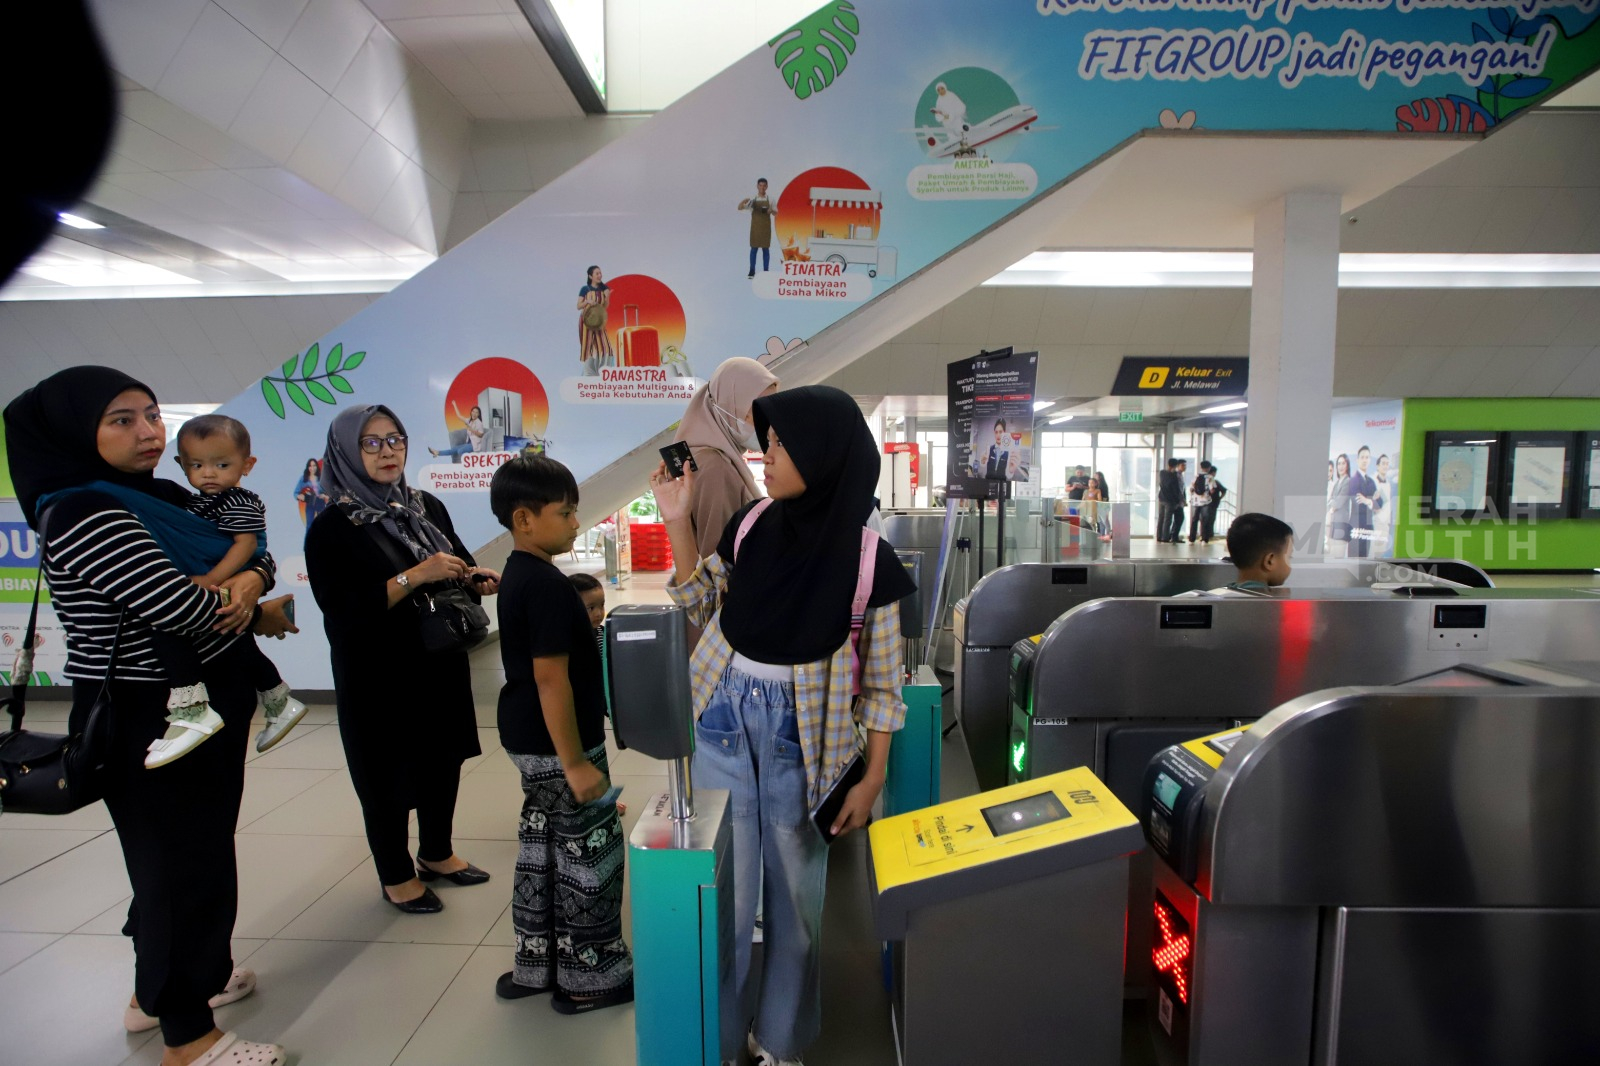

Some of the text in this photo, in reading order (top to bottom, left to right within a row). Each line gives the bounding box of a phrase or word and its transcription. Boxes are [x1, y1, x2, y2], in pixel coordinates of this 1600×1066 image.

[1084, 29, 1552, 82] FIFGROUP jadi pegangan!
[954, 159, 990, 170] AMITRA
[784, 262, 841, 277] FINATRA
[778, 278, 847, 290] Pembiayaan
[778, 288, 847, 298] Usaha Mikro
[601, 369, 667, 382] DANASTRA
[1175, 366, 1233, 377] Keluar Exit
[1148, 372, 1160, 383] D
[577, 382, 634, 392] Pembiayaan
[637, 383, 685, 393] Multiguna
[1170, 380, 1221, 389] Jl. Melawai
[579, 390, 692, 400] Segala Kebutuhan Anda
[1120, 412, 1142, 422] EXIT
[1364, 417, 1397, 429] Telkomsel
[430, 471, 493, 481] Pembiayaan
[435, 480, 476, 489] Perabot
